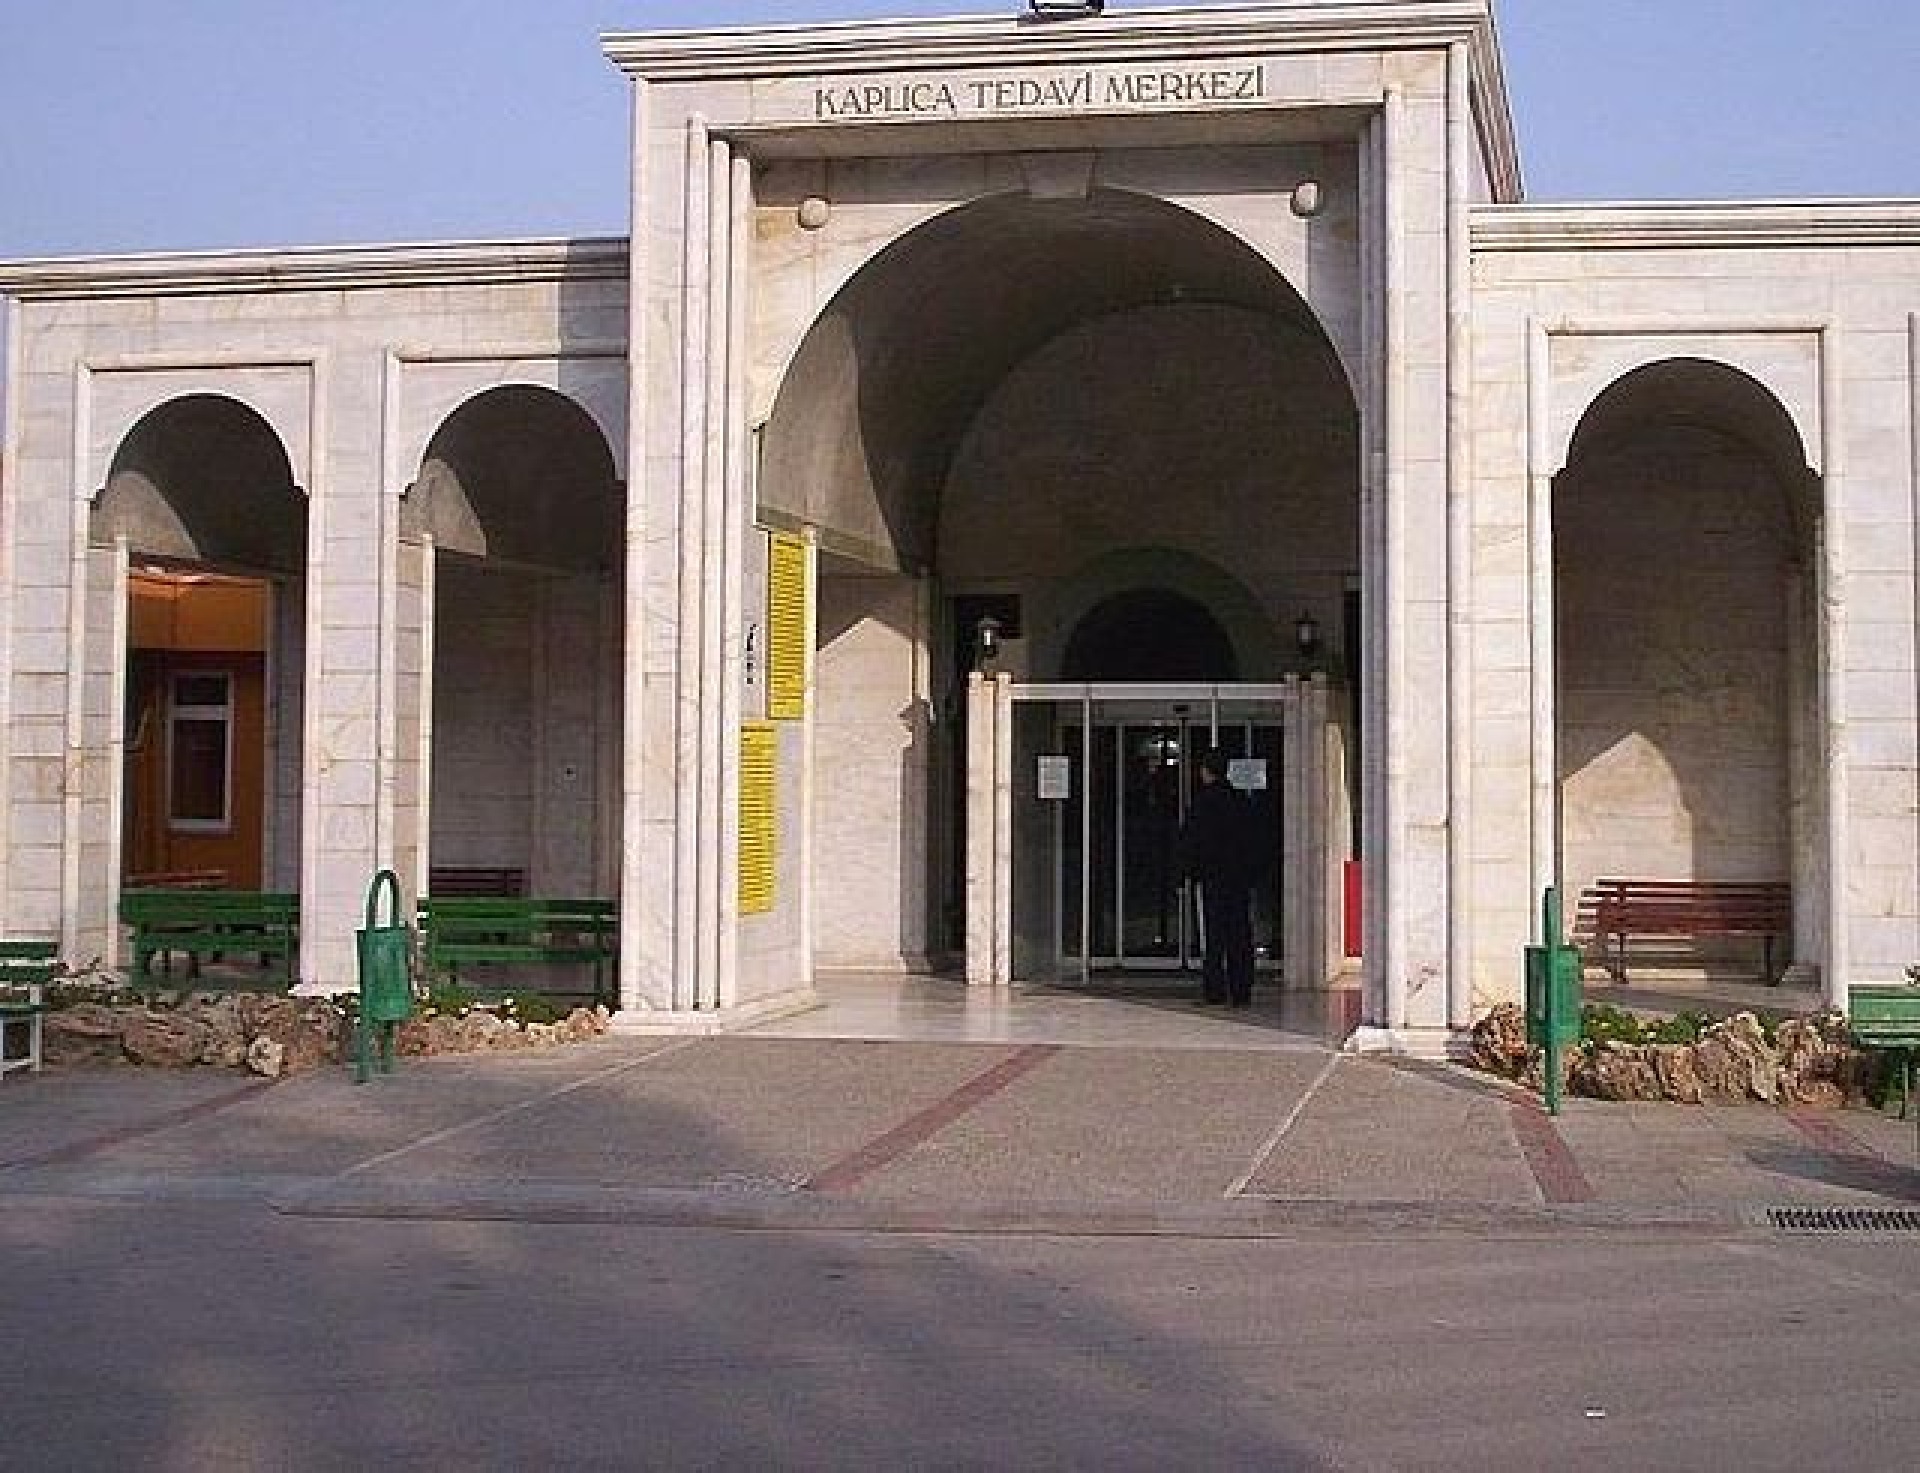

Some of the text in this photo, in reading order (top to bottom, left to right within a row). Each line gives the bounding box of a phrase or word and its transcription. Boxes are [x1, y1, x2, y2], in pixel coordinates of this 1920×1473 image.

[815, 65, 1263, 117] KAPLICA TEDAVİ MERKEZİ
